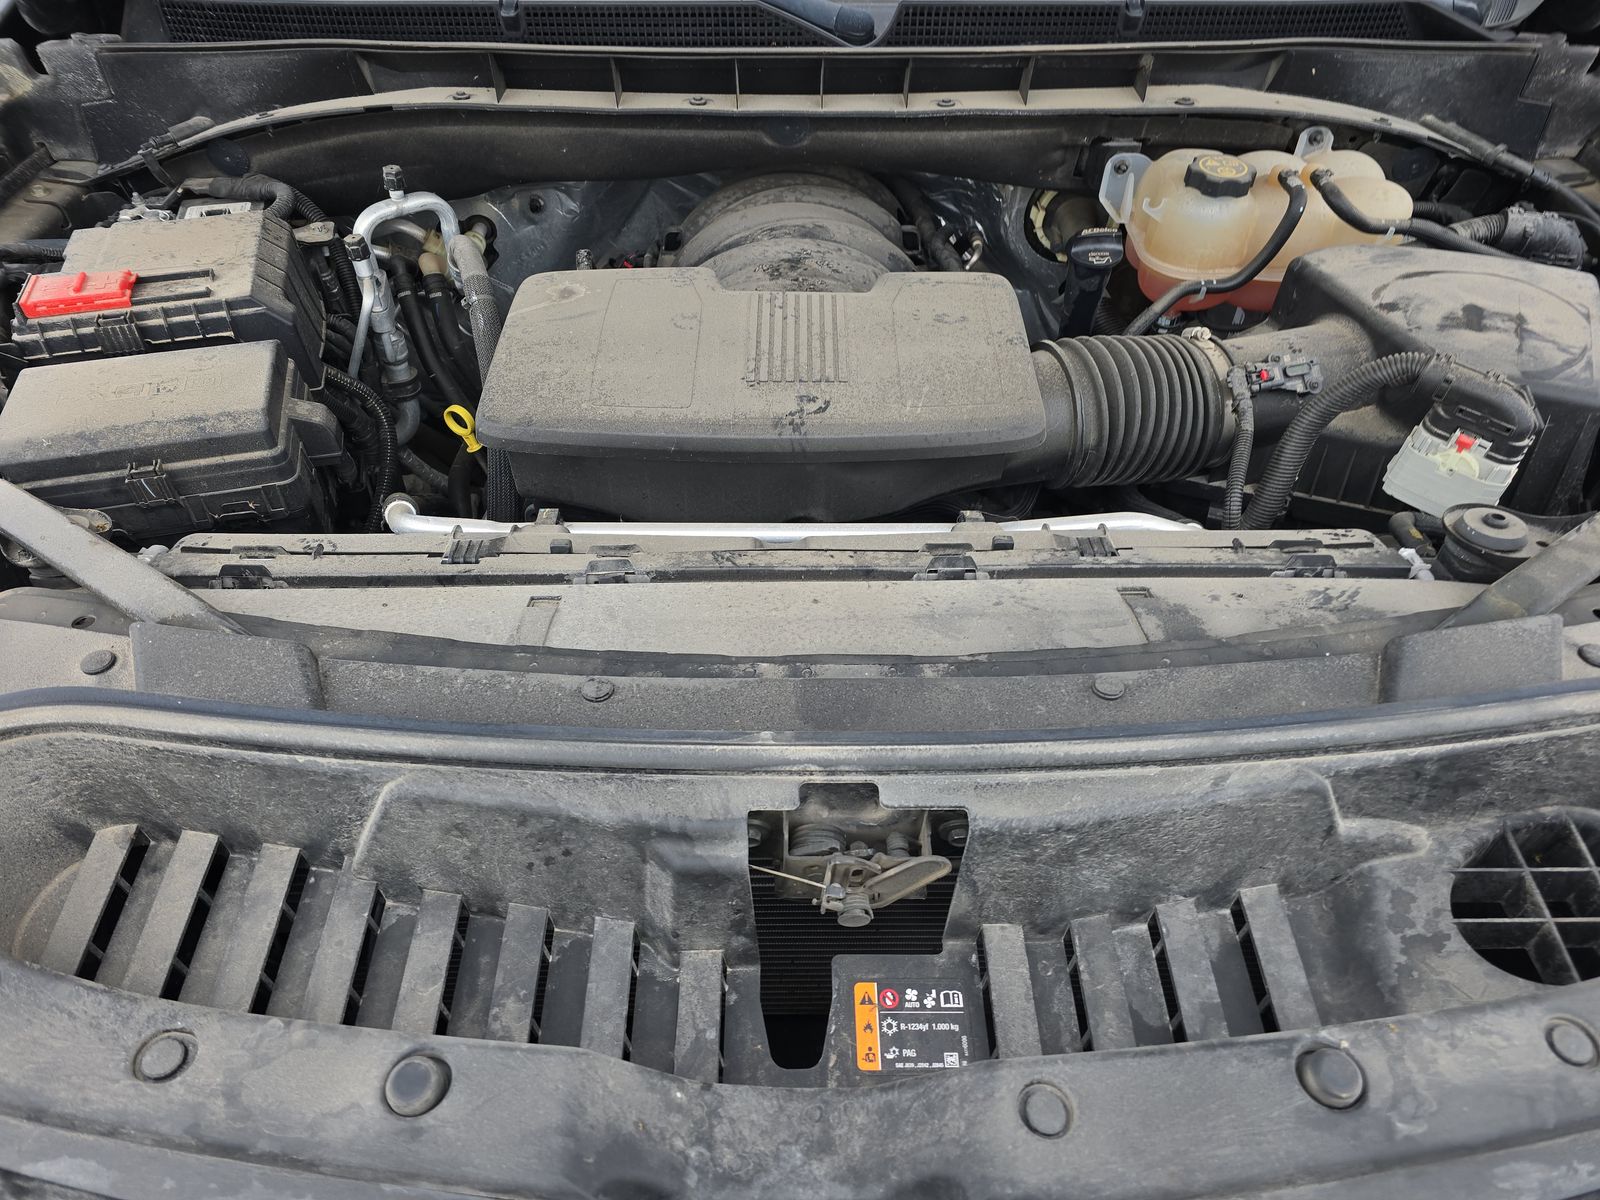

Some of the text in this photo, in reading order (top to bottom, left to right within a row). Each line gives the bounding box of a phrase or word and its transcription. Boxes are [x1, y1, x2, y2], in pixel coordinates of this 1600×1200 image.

[900, 1023, 929, 1031] R-1234yf
[951, 1023, 959, 1031] kg
[903, 1049, 917, 1057] PAG
